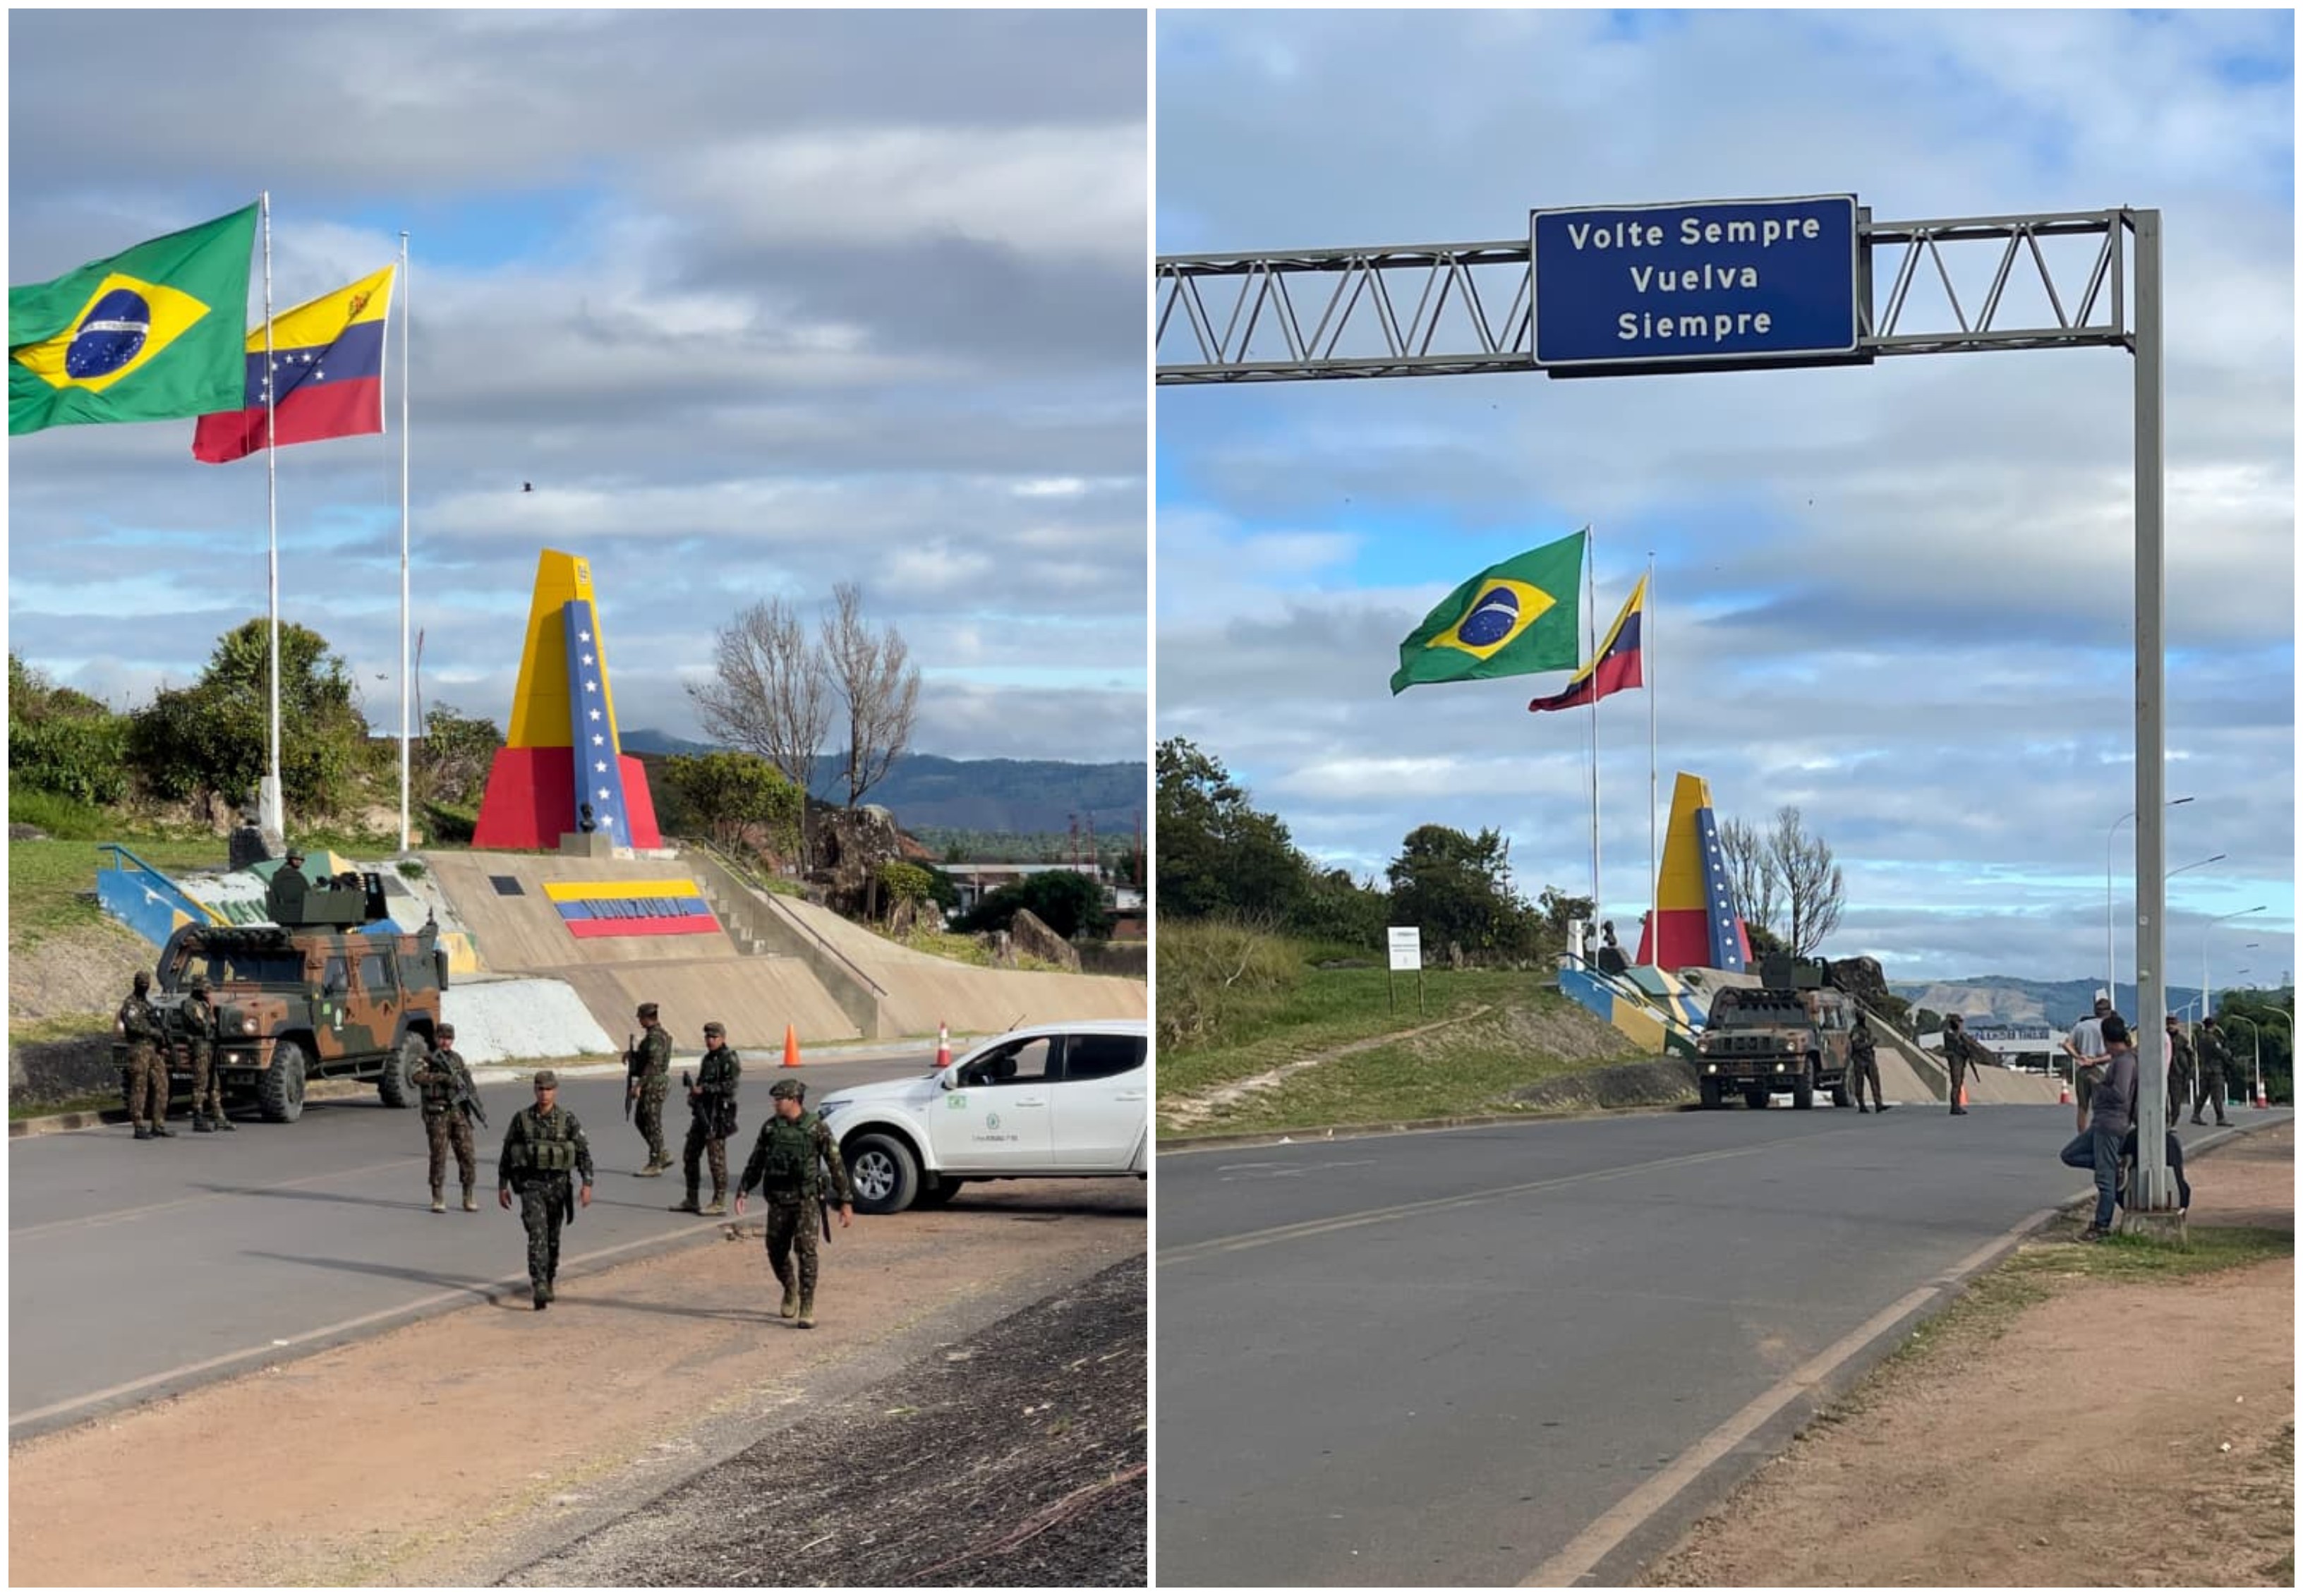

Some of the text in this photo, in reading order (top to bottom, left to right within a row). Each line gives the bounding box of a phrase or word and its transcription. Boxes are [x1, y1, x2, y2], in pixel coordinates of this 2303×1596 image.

[1568, 218, 1820, 250] Volte Sempre
[1630, 264, 1757, 292] Vuelva
[1618, 313, 1771, 341] Siempre
